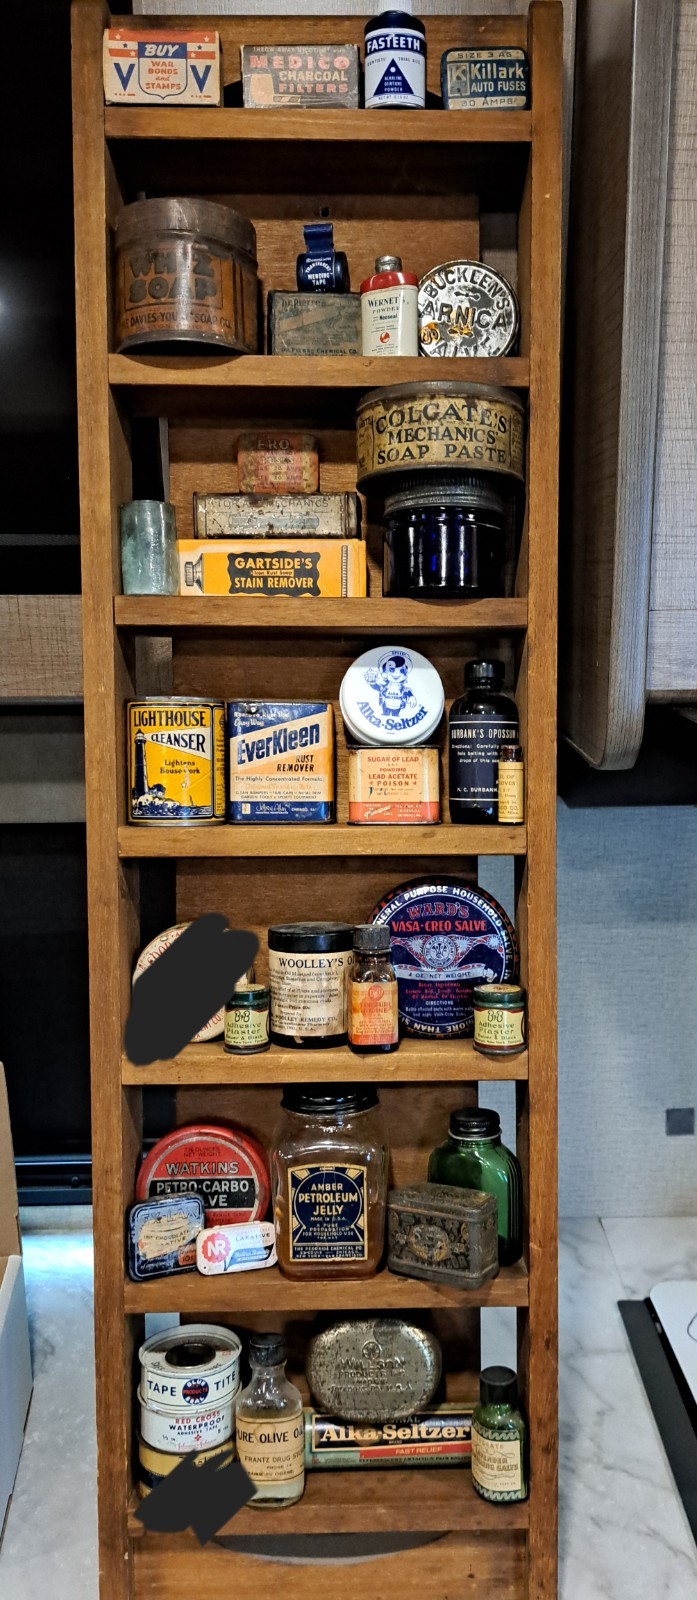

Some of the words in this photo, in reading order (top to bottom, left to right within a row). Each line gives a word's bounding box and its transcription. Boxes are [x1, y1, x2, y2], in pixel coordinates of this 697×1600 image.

[144, 44, 179, 57] BUY
[367, 37, 420, 53] FASTEETH
[250, 55, 350, 70] MEDICO
[114, 63, 135, 92] V
[279, 71, 348, 81] CHARCOAL
[471, 63, 524, 79] Killark
[146, 82, 181, 90] STAMPS
[190, 65, 212, 93] V
[279, 83, 348, 93] FILTERS
[471, 82, 494, 92] AUTO
[498, 81, 526, 91] FUSES
[482, 98, 513, 106] AMPS
[129, 252, 215, 278] WHZ
[305, 262, 331, 273] TRANSPARENT
[129, 277, 217, 303] SOAP
[424, 267, 510, 310] BUCKLEN'S
[419, 301, 508, 332] ARNICA
[376, 403, 507, 434] COLGATE'S
[388, 427, 499, 445] MECHANICS'
[378, 445, 430, 464] SOAP
[445, 444, 507, 463] PASTE
[234, 558, 313, 569] GARTSIDE'S
[234, 578, 264, 588] STAIN
[268, 577, 314, 588] REMOVER
[134, 711, 206, 727] LIGHTHOUSE
[357, 702, 428, 730] Alka-Seltzer
[151, 734, 205, 753] CLEANSER
[238, 724, 319, 765] EverKleen
[296, 755, 314, 763] RUST
[277, 764, 314, 772] REMOVER
[376, 899, 402, 925] NERAL
[404, 885, 448, 900] PURPOSE
[407, 902, 469, 919] WARD'S
[392, 921, 452, 932] VASA-CREO
[455, 920, 487, 932] SALVE
[278, 957, 344, 969] WOOLLEY'S
[413, 1023, 440, 1033] THAN
[166, 1161, 239, 1175] WATKINS
[311, 1183, 343, 1191] AMBER
[298, 1192, 358, 1203] PETROLEUM
[313, 1205, 344, 1215] JELLY
[208, 1240, 226, 1257] NR
[147, 1380, 176, 1396] TAPE
[214, 1370, 235, 1390] TITE
[187, 1379, 206, 1387] BLUE
[185, 1396, 204, 1404] SEAL
[169, 1415, 224, 1430] WATERPROOF
[196, 1411, 220, 1423] CROSS
[260, 1432, 289, 1444] OLIVE
[320, 1423, 470, 1442] Alka-Seltzer
